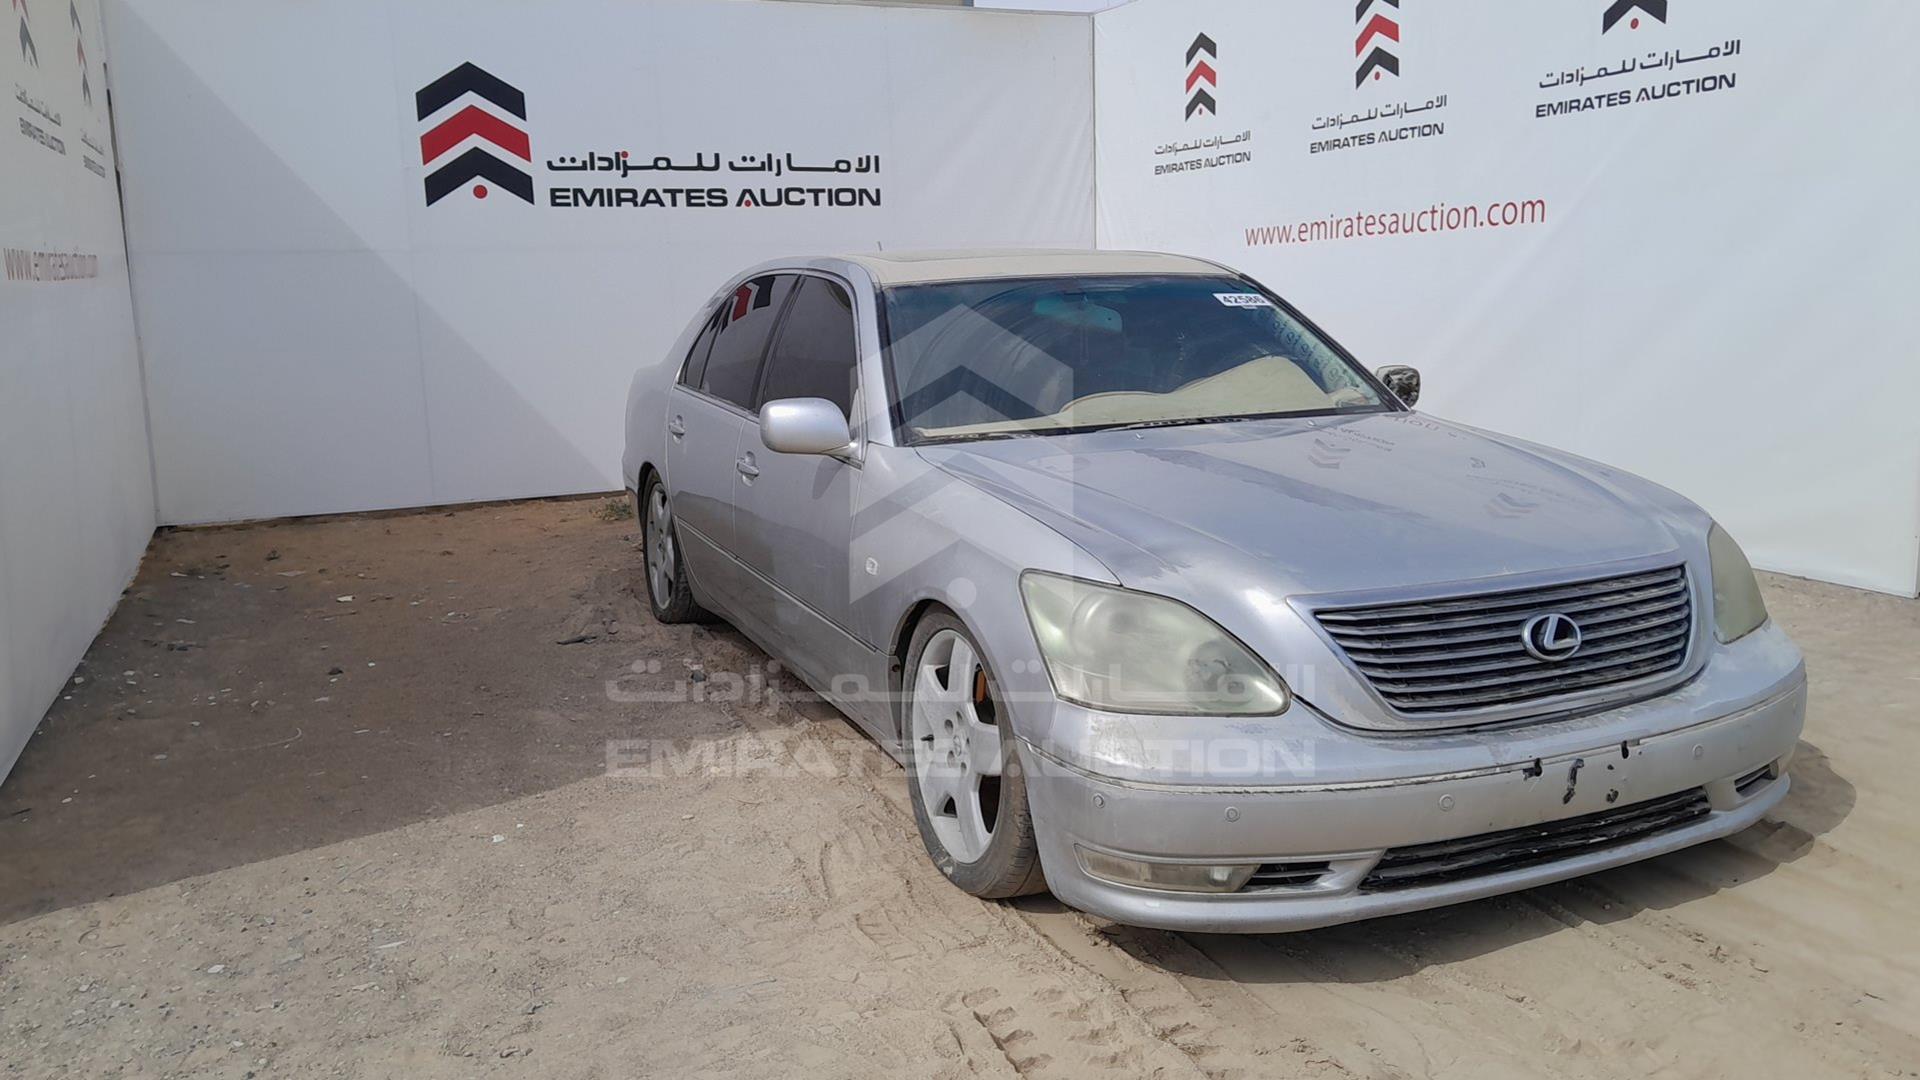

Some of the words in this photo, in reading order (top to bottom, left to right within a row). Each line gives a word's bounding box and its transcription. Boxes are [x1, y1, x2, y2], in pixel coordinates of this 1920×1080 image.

[1535, 90, 1632, 118] EMIRATES
[1635, 72, 1737, 103] AUCTION
[1309, 132, 1376, 155] EMIRATES
[1377, 122, 1445, 144] AUCTION
[1153, 158, 1203, 176] EMIRATES
[1203, 151, 1252, 169] AUCTION
[549, 186, 728, 208] EMIRATES
[736, 186, 881, 208] AUCTION
[1244, 198, 1547, 247] www.emiratesauction.com
